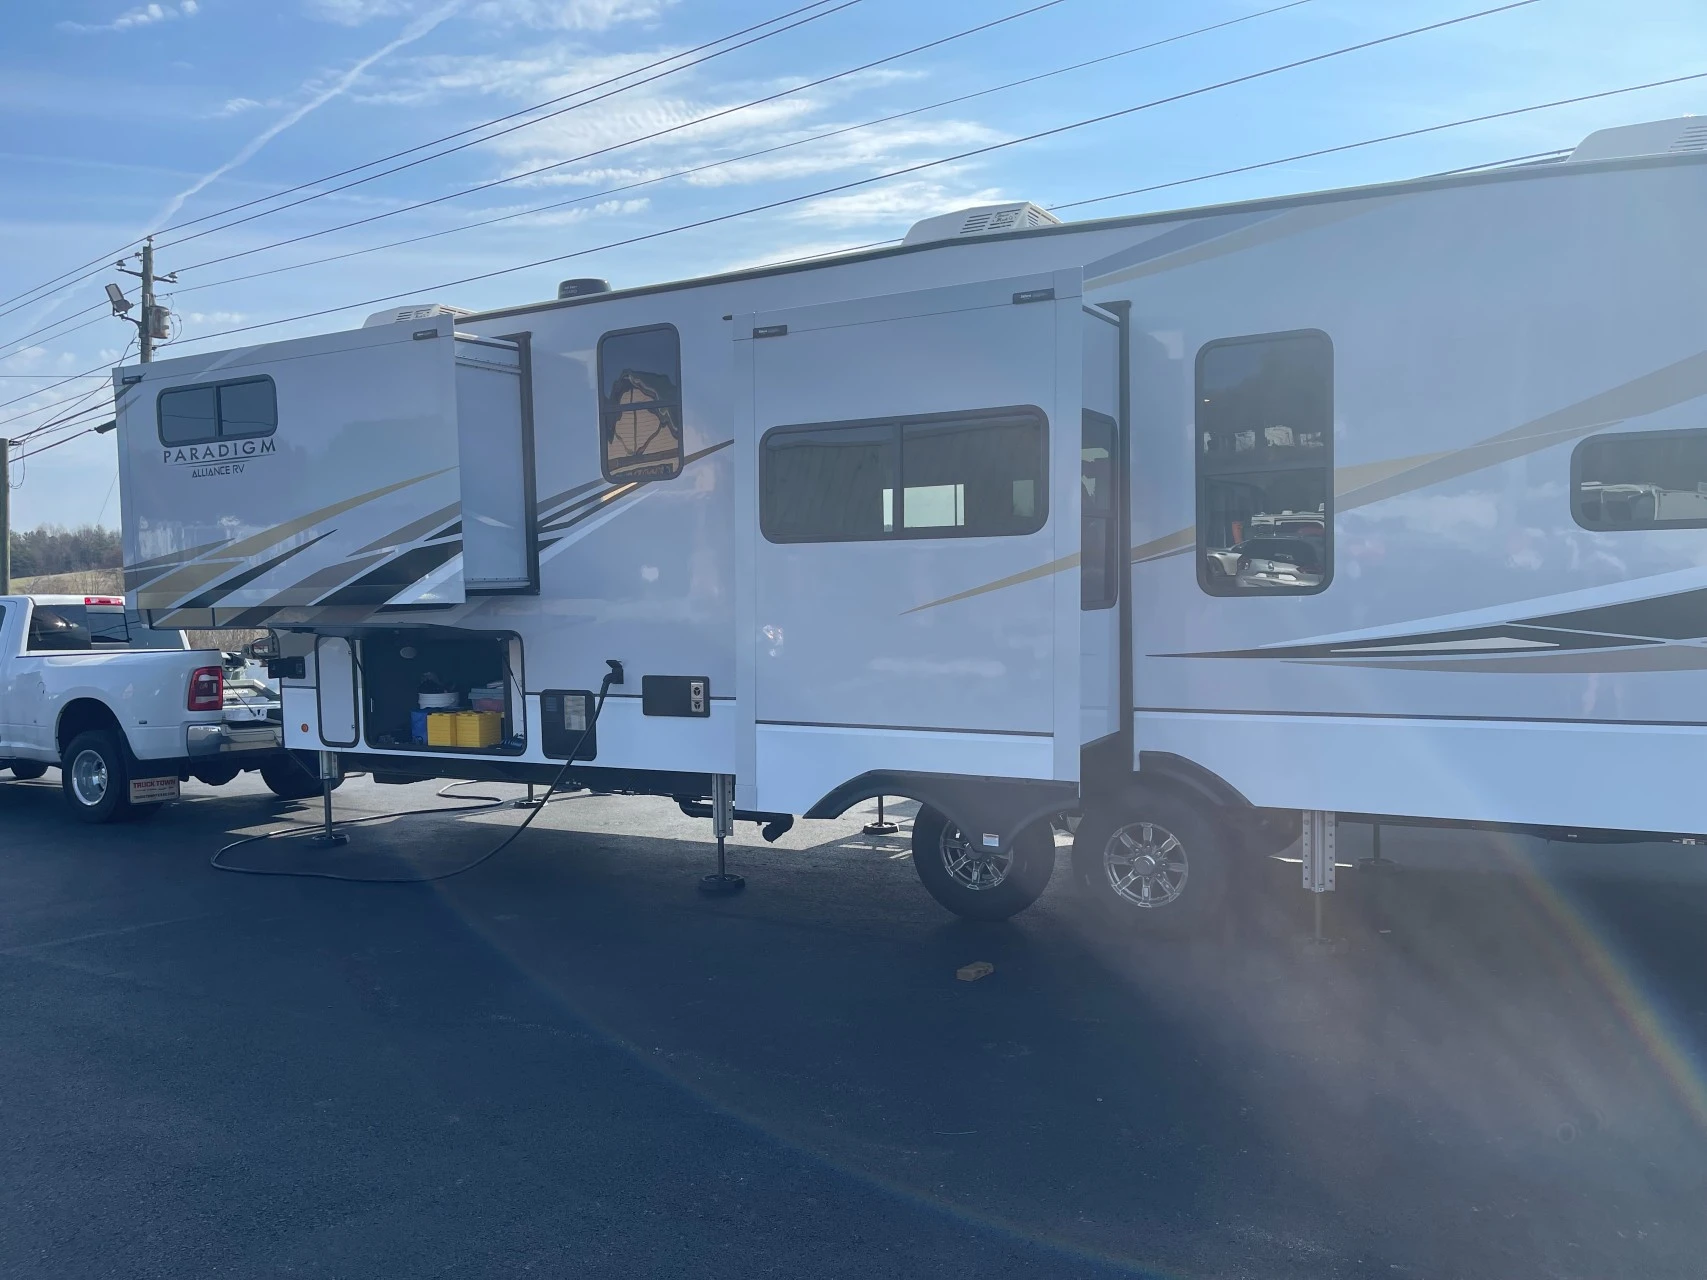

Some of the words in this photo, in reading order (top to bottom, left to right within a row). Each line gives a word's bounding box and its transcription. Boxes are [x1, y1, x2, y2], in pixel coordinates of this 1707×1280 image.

[163, 438, 276, 463] PARADIGM
[192, 465, 231, 478] ALLIANCE
[232, 464, 245, 474] RV
[133, 781, 155, 789] TRUCK
[156, 779, 176, 787] TOWN
